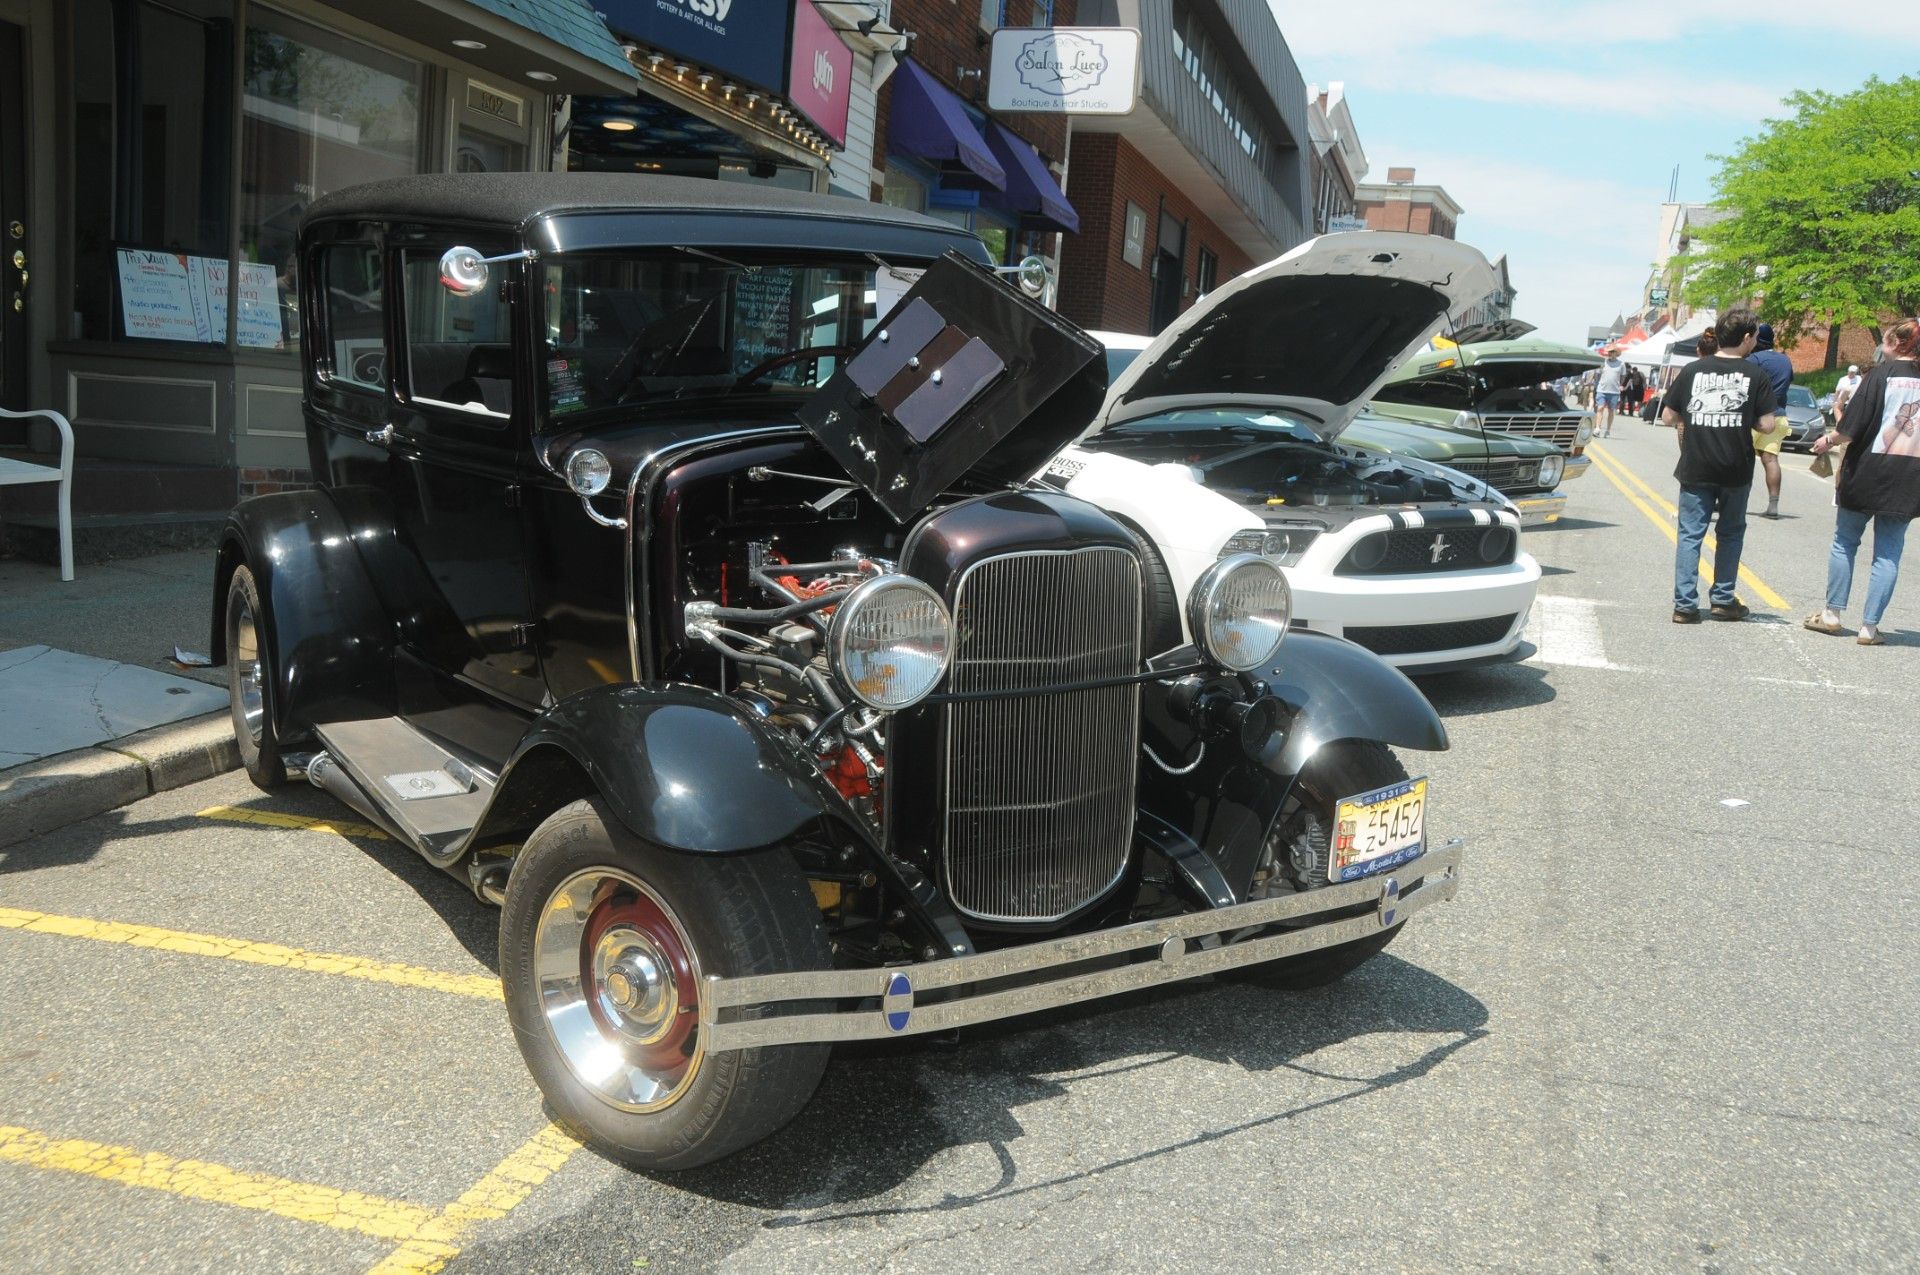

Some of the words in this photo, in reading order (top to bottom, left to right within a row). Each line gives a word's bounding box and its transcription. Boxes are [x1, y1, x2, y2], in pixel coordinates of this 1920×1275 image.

[684, 12, 694, 23] ART
[694, 15, 704, 27] FOR
[705, 20, 713, 31] ALL
[714, 24, 726, 36] AGES
[1023, 49, 1064, 70] Salon
[1069, 50, 1102, 74] Luce
[1011, 98, 1050, 109] Boutique
[1052, 99, 1058, 108] &
[1061, 100, 1078, 109] Hair
[1081, 100, 1108, 109] Studio
[765, 276, 792, 285] CLASSES
[1052, 456, 1087, 471] BOSS
[1376, 789, 1399, 801] 1931
